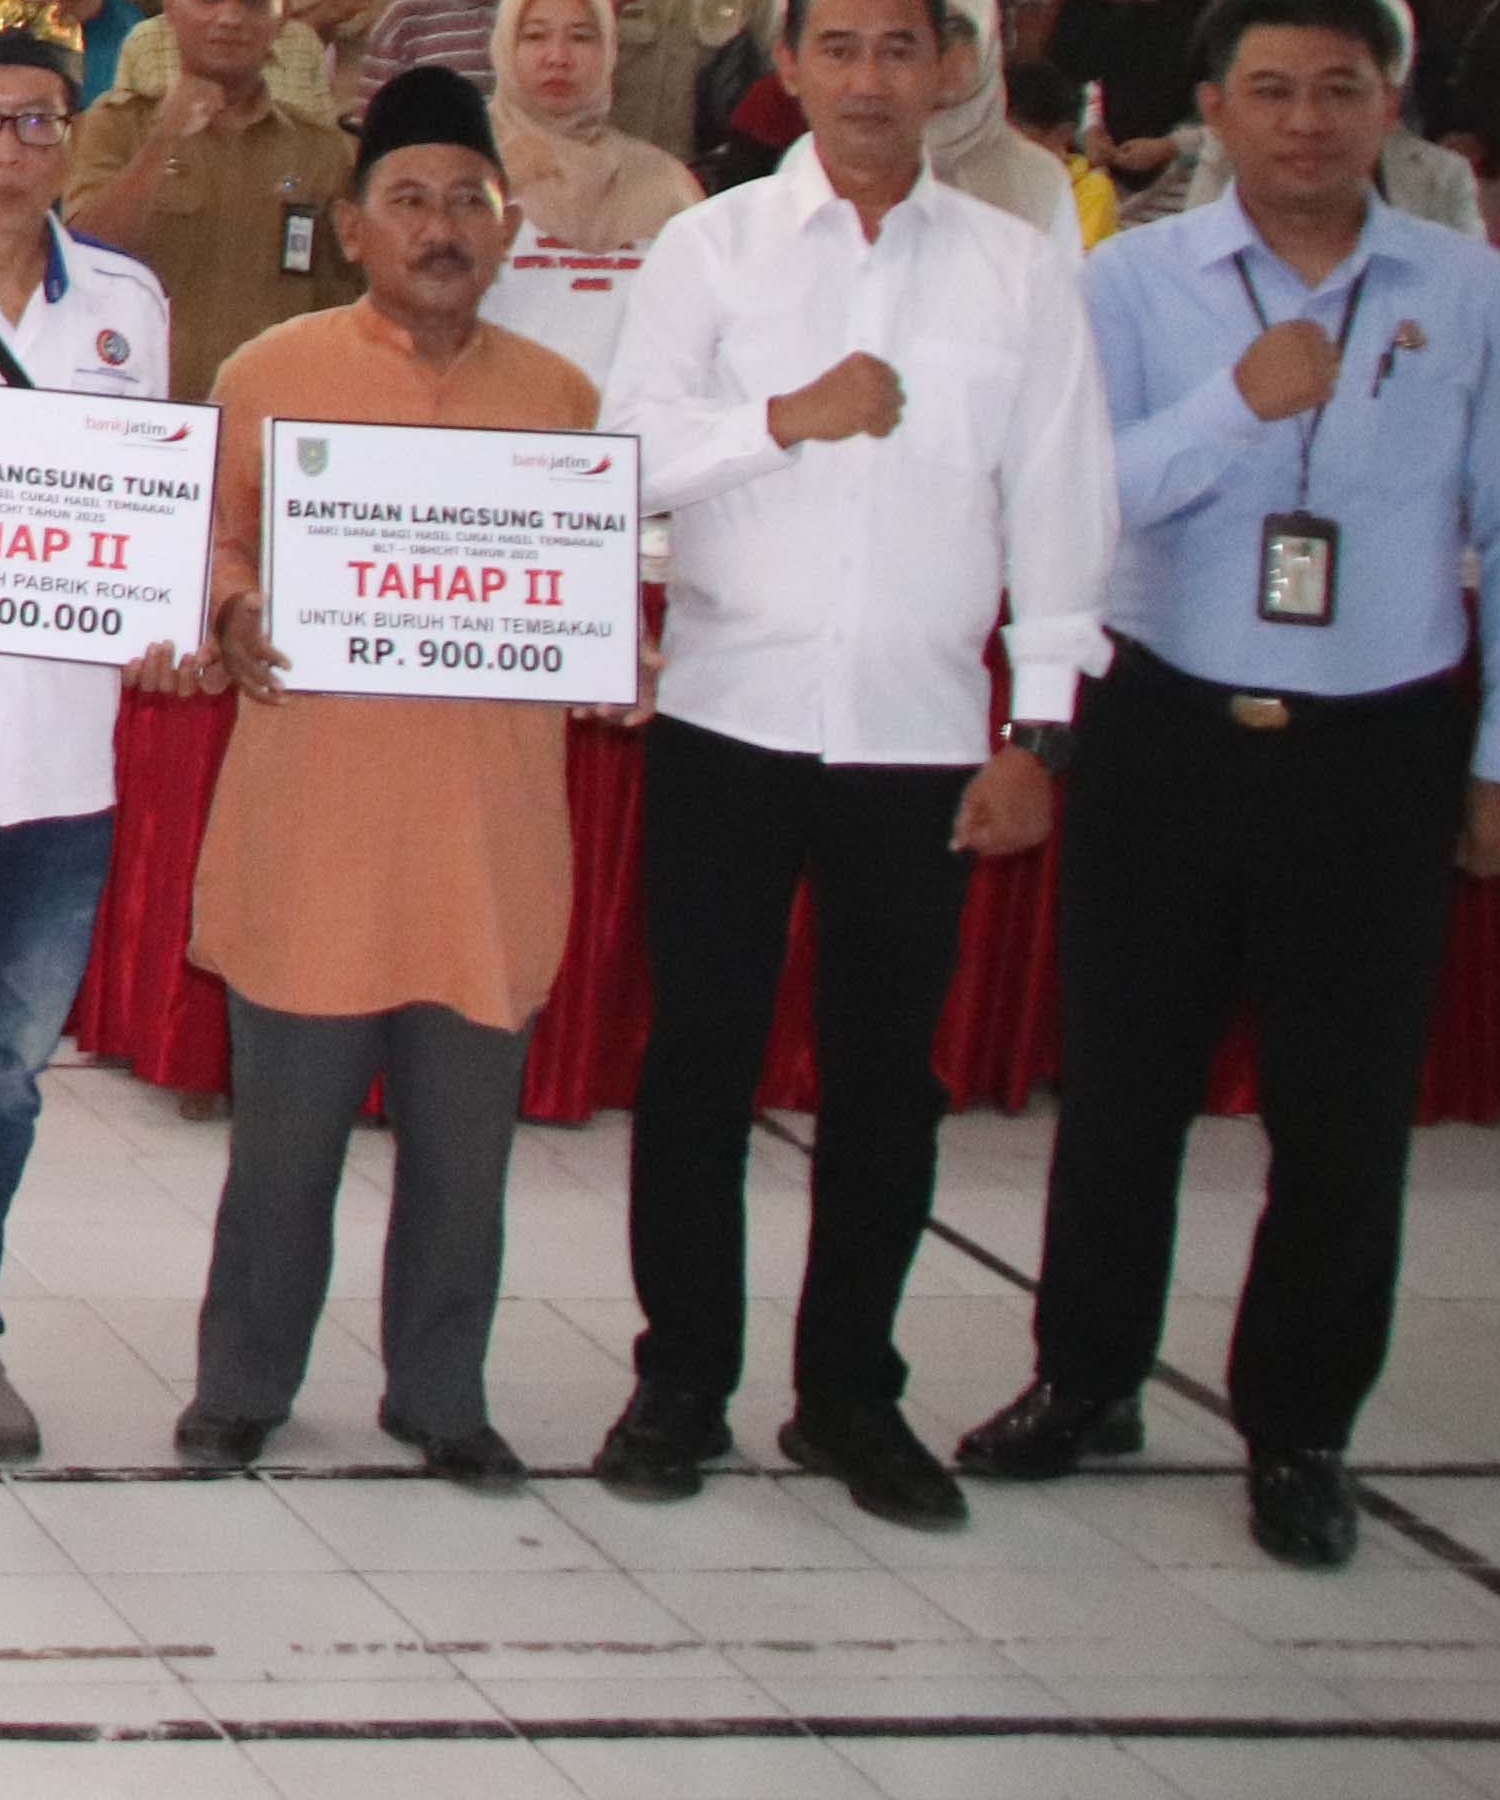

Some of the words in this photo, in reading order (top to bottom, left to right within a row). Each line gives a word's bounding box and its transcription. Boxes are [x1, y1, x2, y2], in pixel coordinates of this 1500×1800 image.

[123, 475, 200, 501] TUNAI
[287, 499, 403, 523] BANTUAN
[411, 504, 543, 529] LANGSUNG
[552, 511, 625, 532] TUNAI
[87, 532, 131, 570] II
[12, 573, 90, 595] PABRIK
[95, 581, 172, 604] ROKOK
[348, 560, 506, 603] TAHAP
[524, 568, 565, 606] II
[299, 609, 367, 627] UNTUK
[373, 611, 444, 630] BURUH
[450, 615, 494, 632] TANI
[501, 618, 612, 638] TEMBAKAU
[348, 637, 404, 666] RP.
[418, 642, 563, 672] 900.000
